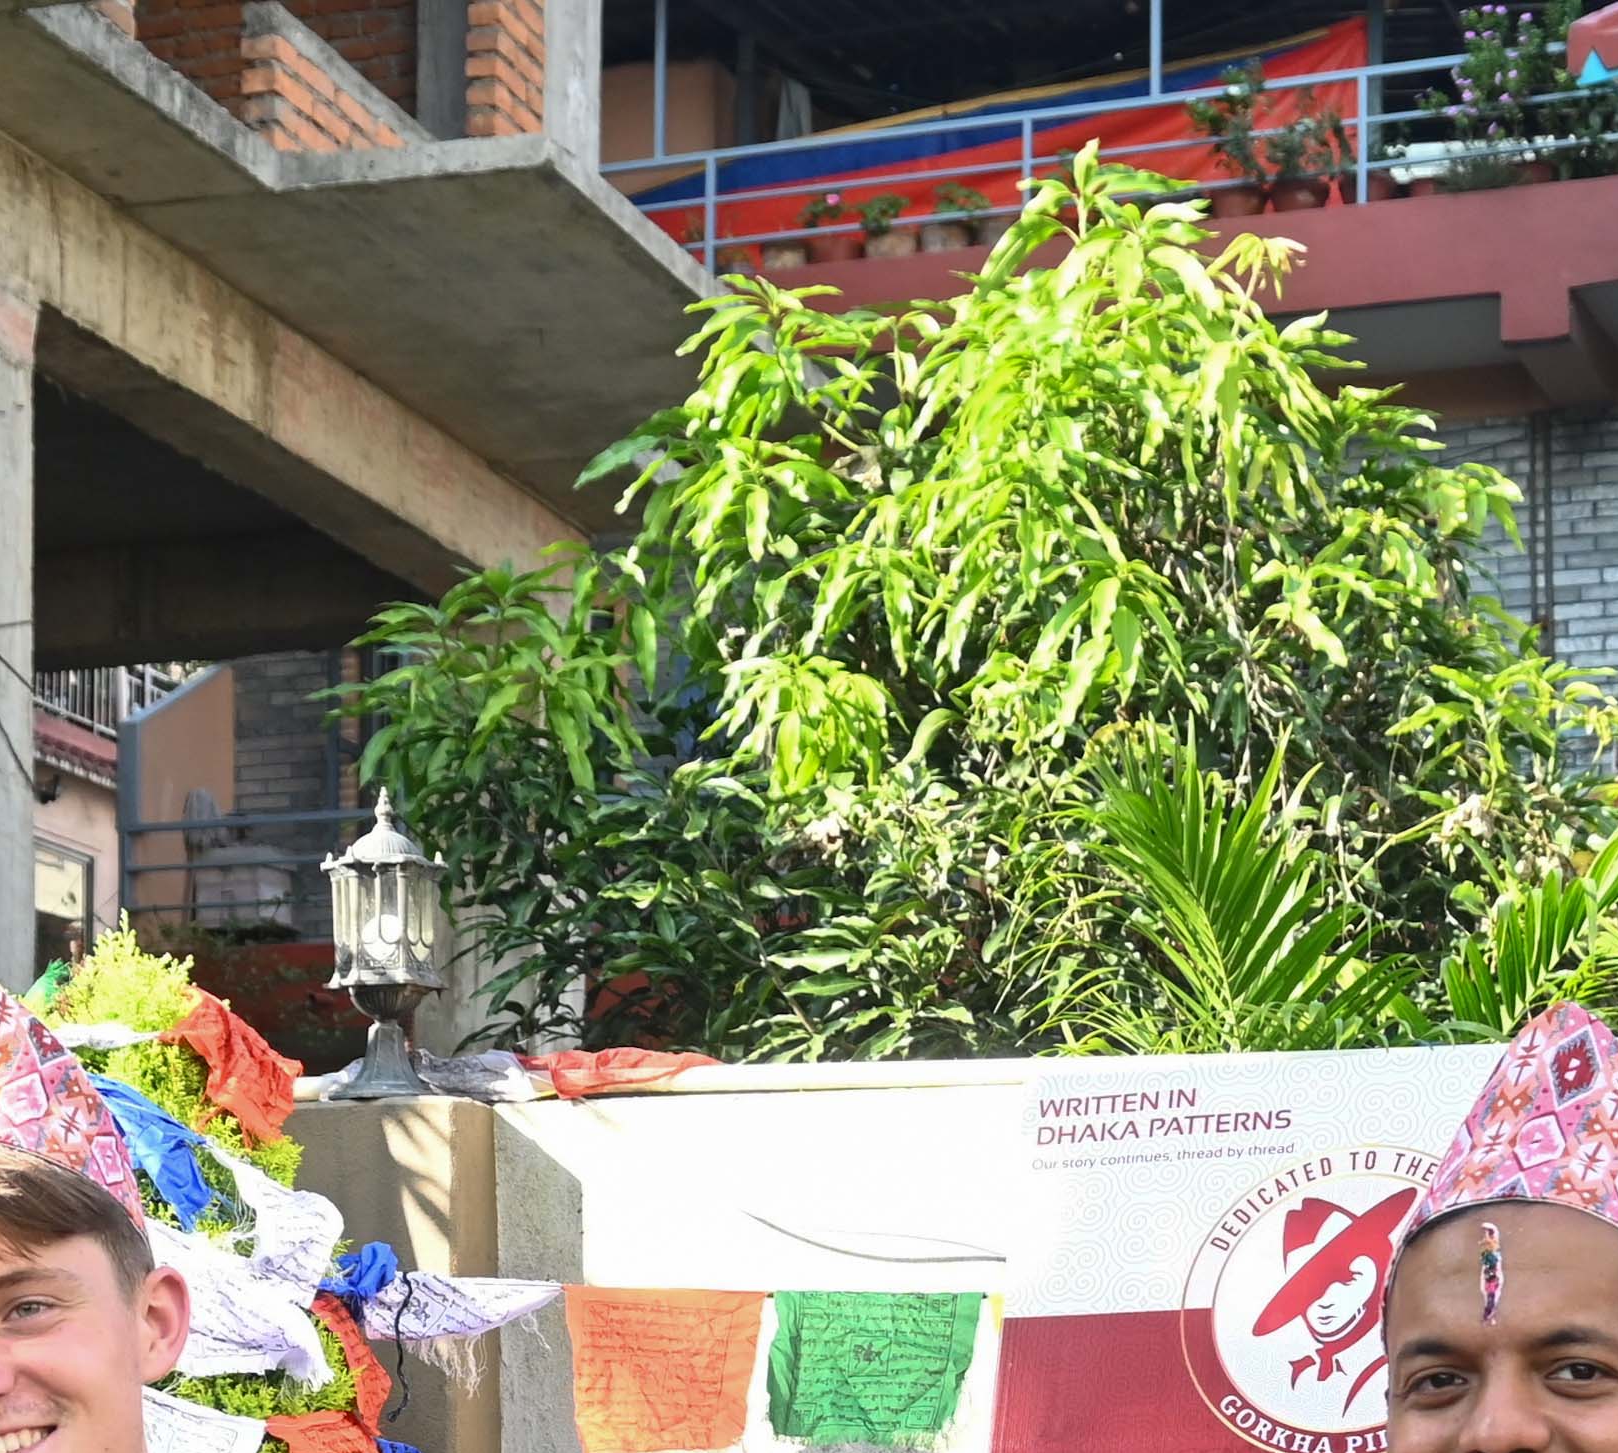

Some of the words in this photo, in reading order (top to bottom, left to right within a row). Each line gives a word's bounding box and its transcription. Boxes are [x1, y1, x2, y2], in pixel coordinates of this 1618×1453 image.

[1039, 1091, 1161, 1119] WRITTEN
[1168, 1087, 1197, 1109] IN
[1036, 1119, 1140, 1146] DHAKA
[1148, 1109, 1293, 1138] PATTERNS
[1031, 1158, 1059, 1171] Our
[1061, 1156, 1097, 1170] story
[1100, 1151, 1174, 1167] continues,
[1176, 1146, 1223, 1162] thread
[1227, 1146, 1244, 1161] by
[1210, 1156, 1333, 1252] DEDICATED
[1348, 1150, 1378, 1171] TO
[1392, 1152, 1440, 1183] THE
